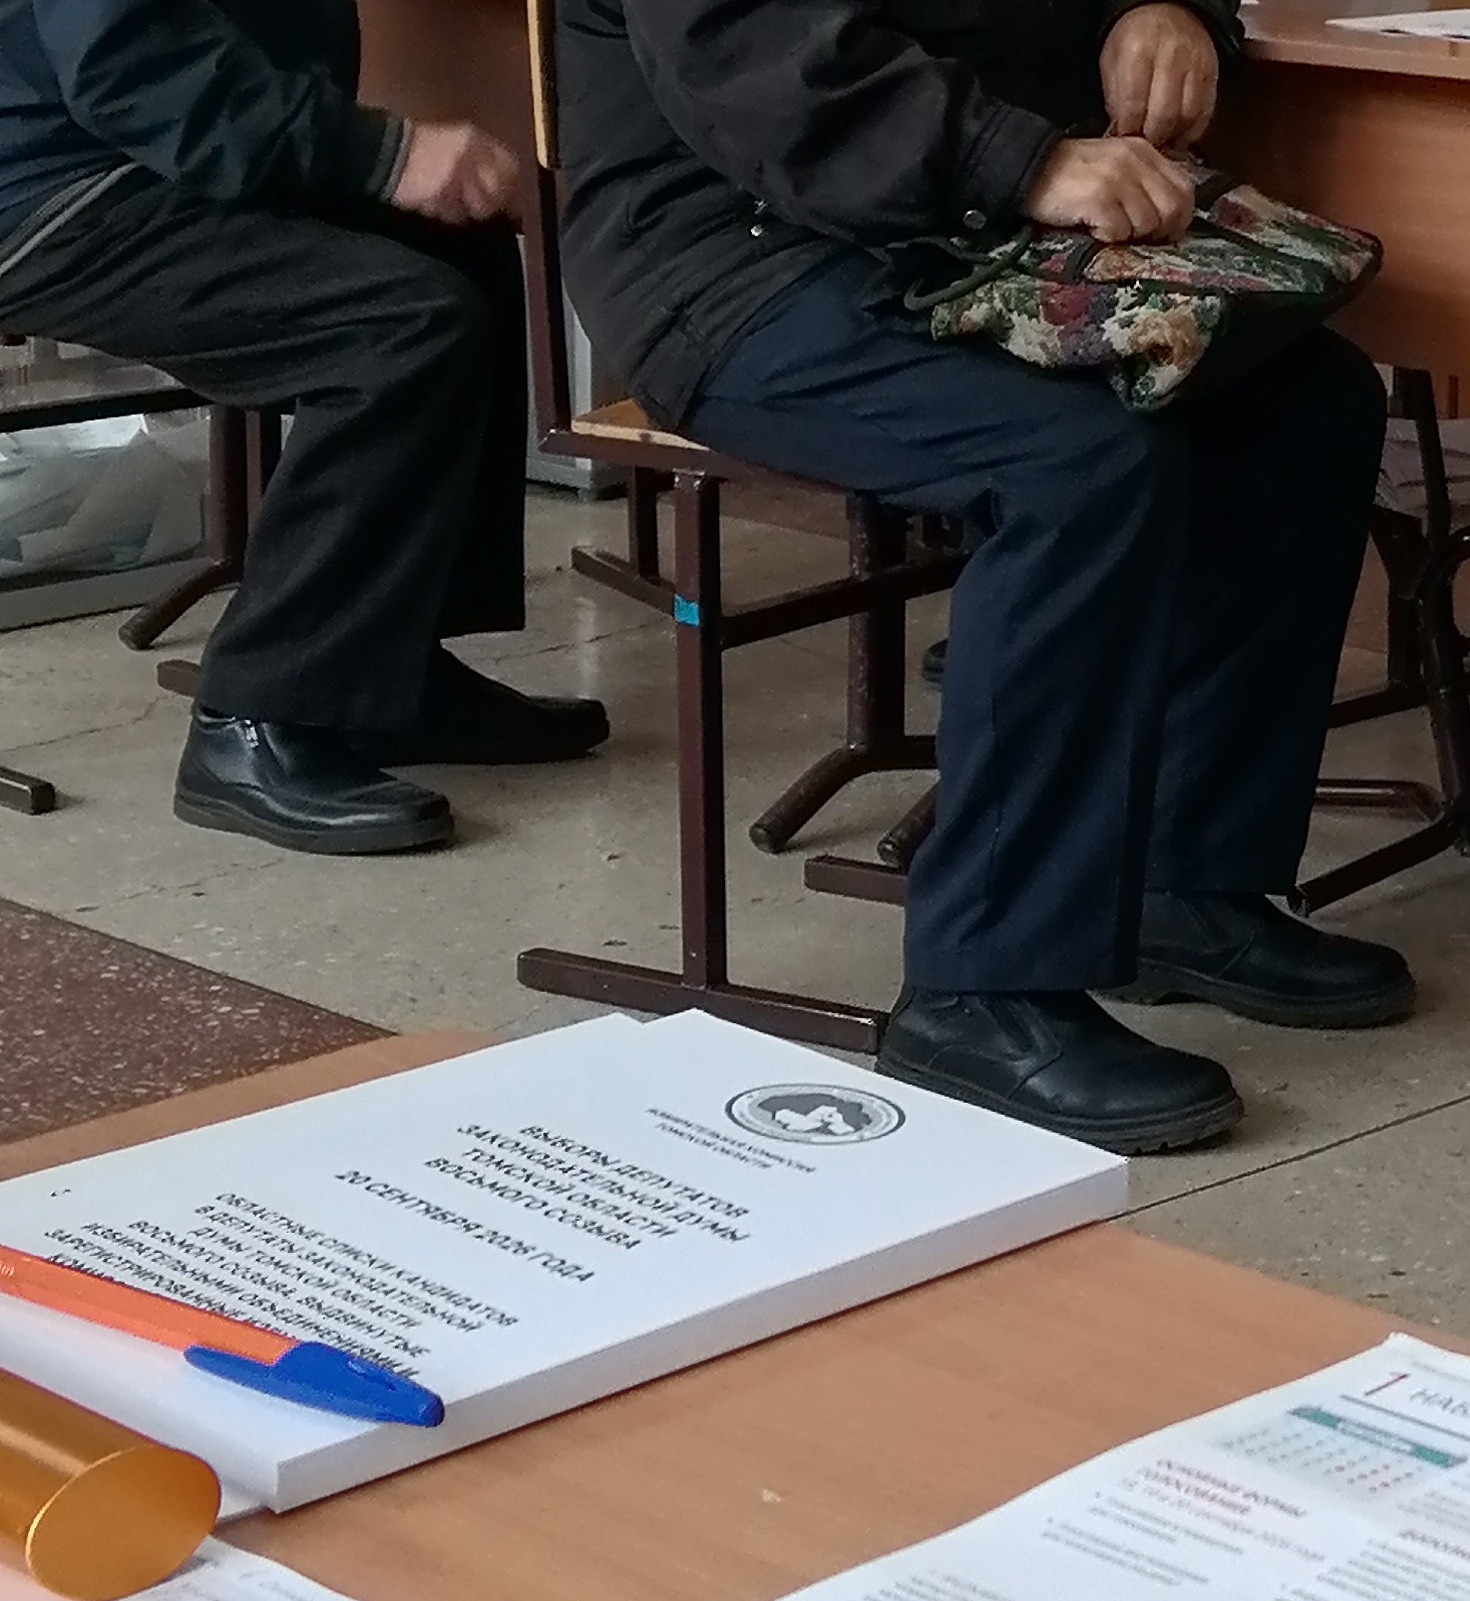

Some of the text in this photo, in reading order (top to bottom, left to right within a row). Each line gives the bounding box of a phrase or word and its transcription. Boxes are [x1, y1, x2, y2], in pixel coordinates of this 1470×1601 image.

[424, 1158, 640, 1249] ВОСЬМОГО СОЗЫВА
[457, 1125, 749, 1241] ЗАКОНОДАТЕЛЬНОЙ ДУМЫ
[462, 1147, 676, 1237] ТОМСКОЙ ОБЛАСТИ
[519, 1126, 748, 1217] ВЫБОРЫ ДЕПУТАТОВ
[215, 1193, 323, 1240] ОБЛАСТНЫЕ
[390, 1269, 518, 1326] КАНДИДАТОВ
[334, 1170, 371, 1184] 20
[365, 1182, 482, 1232] СЕНТЯБРЯ
[528, 1252, 594, 1282] ГОДА
